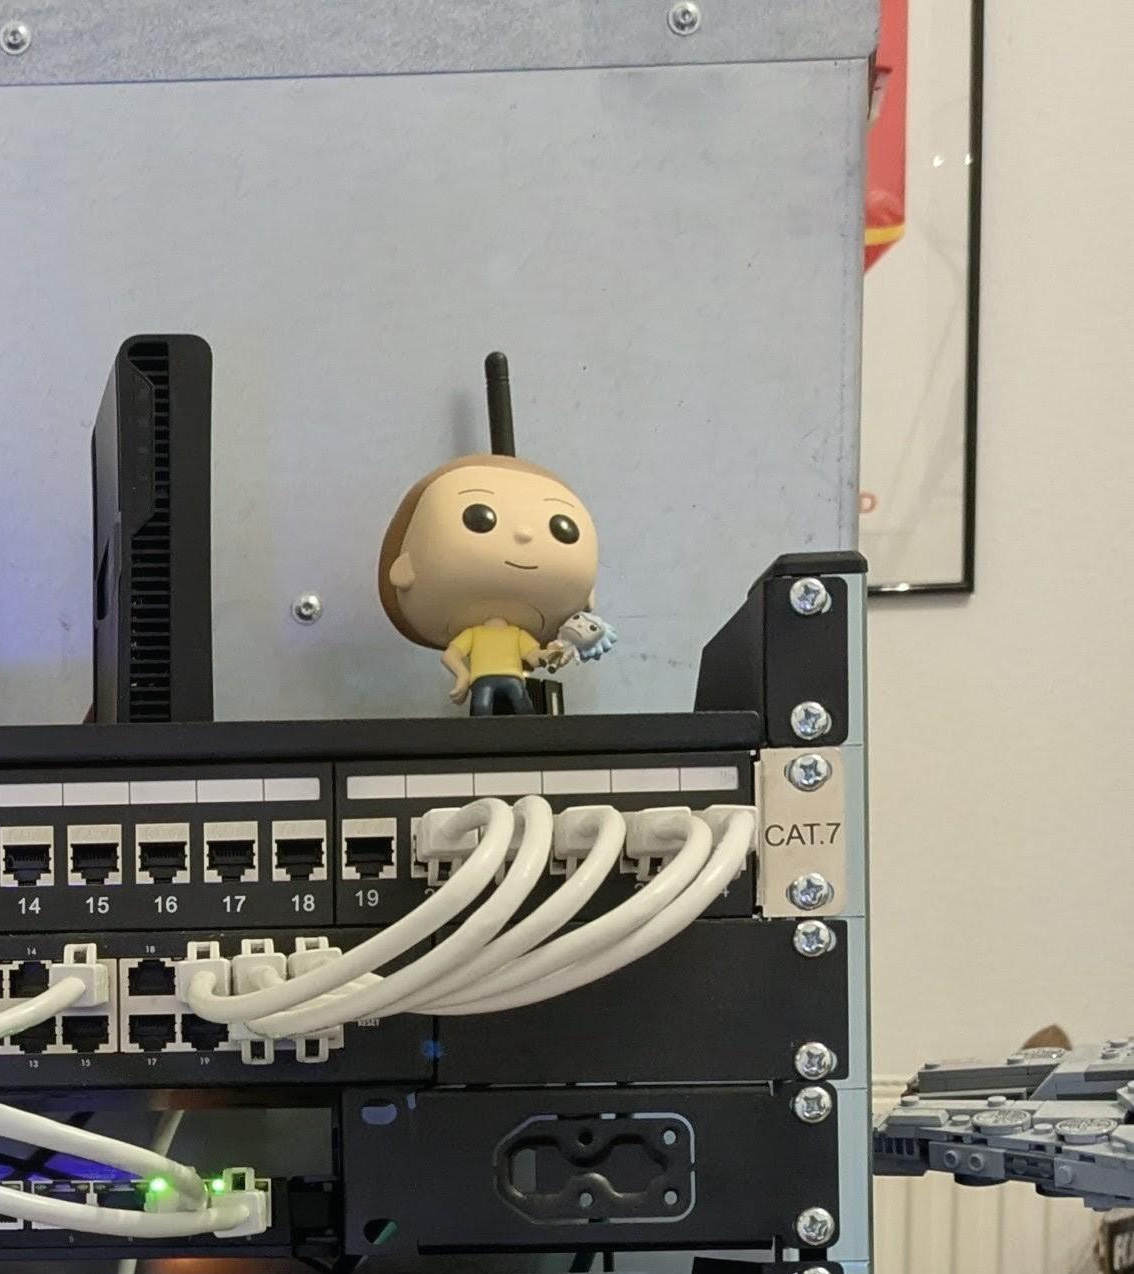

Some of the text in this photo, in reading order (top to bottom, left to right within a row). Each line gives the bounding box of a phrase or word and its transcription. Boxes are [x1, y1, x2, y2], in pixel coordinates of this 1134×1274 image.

[764, 822, 841, 847] CAT.7
[18, 898, 41, 914] 14
[86, 897, 110, 914] 15
[154, 896, 178, 913] 16
[223, 895, 246, 912] 17
[291, 895, 315, 912] 18
[355, 889, 379, 907] 19
[26, 947, 37, 956] 14
[145, 945, 155, 954] 18
[29, 1060, 39, 1068] 13
[81, 1058, 91, 1067] 15
[147, 1058, 157, 1066] 17
[200, 1057, 210, 1065] 19
